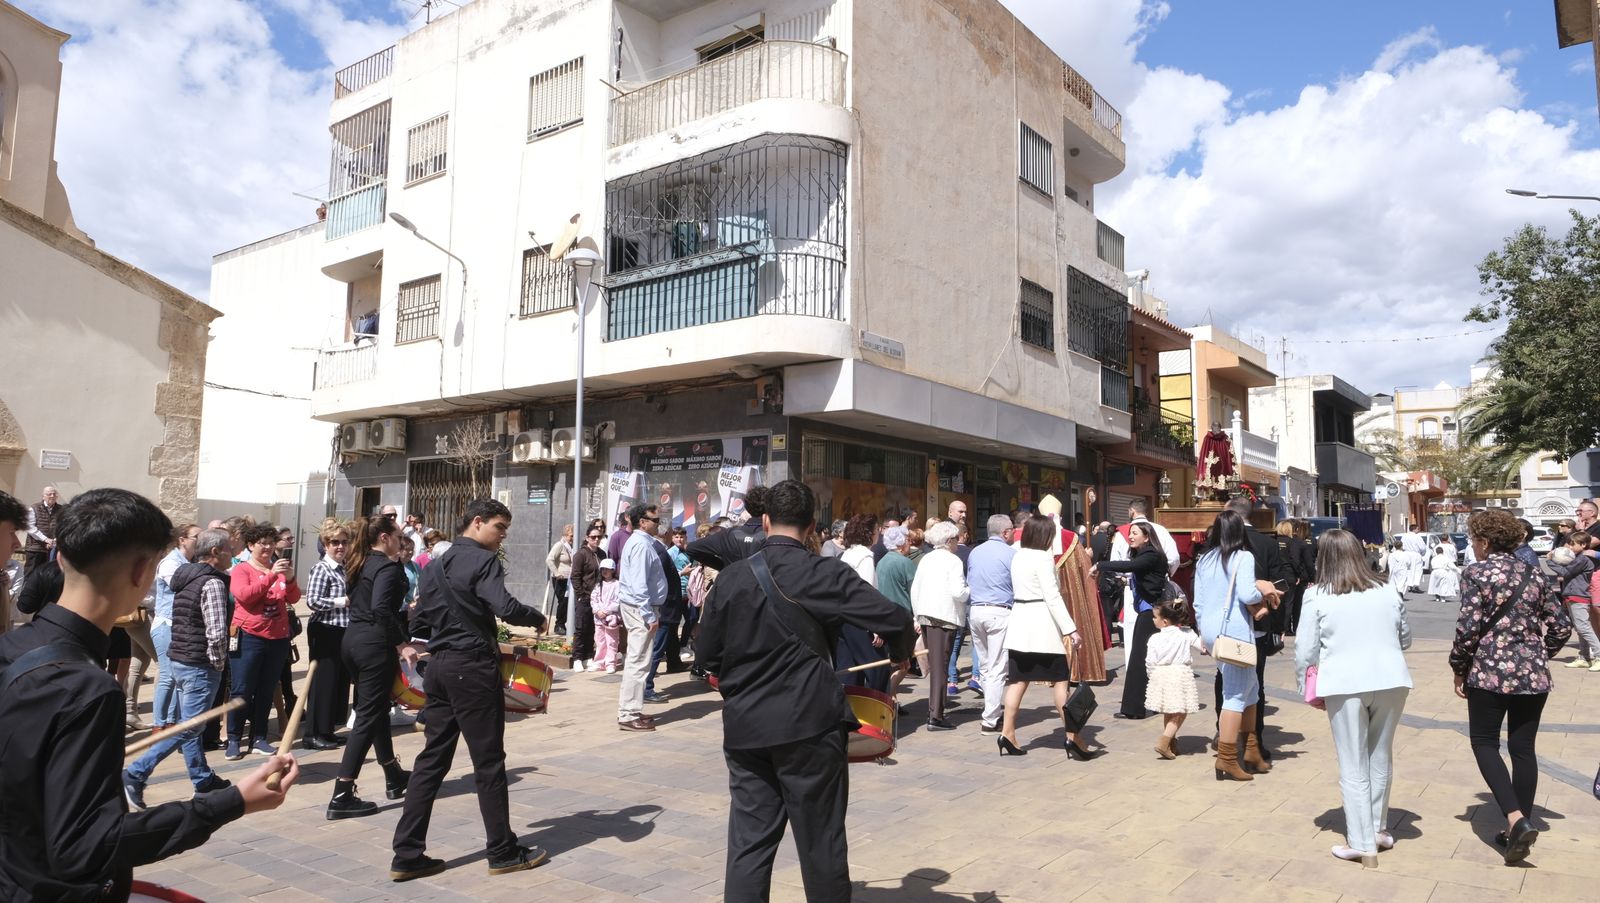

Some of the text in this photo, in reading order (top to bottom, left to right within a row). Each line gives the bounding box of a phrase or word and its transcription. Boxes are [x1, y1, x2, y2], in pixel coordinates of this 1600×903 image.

[650, 456, 668, 464] MÁXIMO
[686, 454, 705, 463] MÁXIMO
[724, 457, 741, 467] NADA
[614, 464, 629, 473] NADA
[664, 463, 682, 471] AZÚCAR
[701, 461, 719, 469] AZÚCAR
[612, 477, 630, 487] MEJOR
[721, 472, 742, 483] MEJOR
